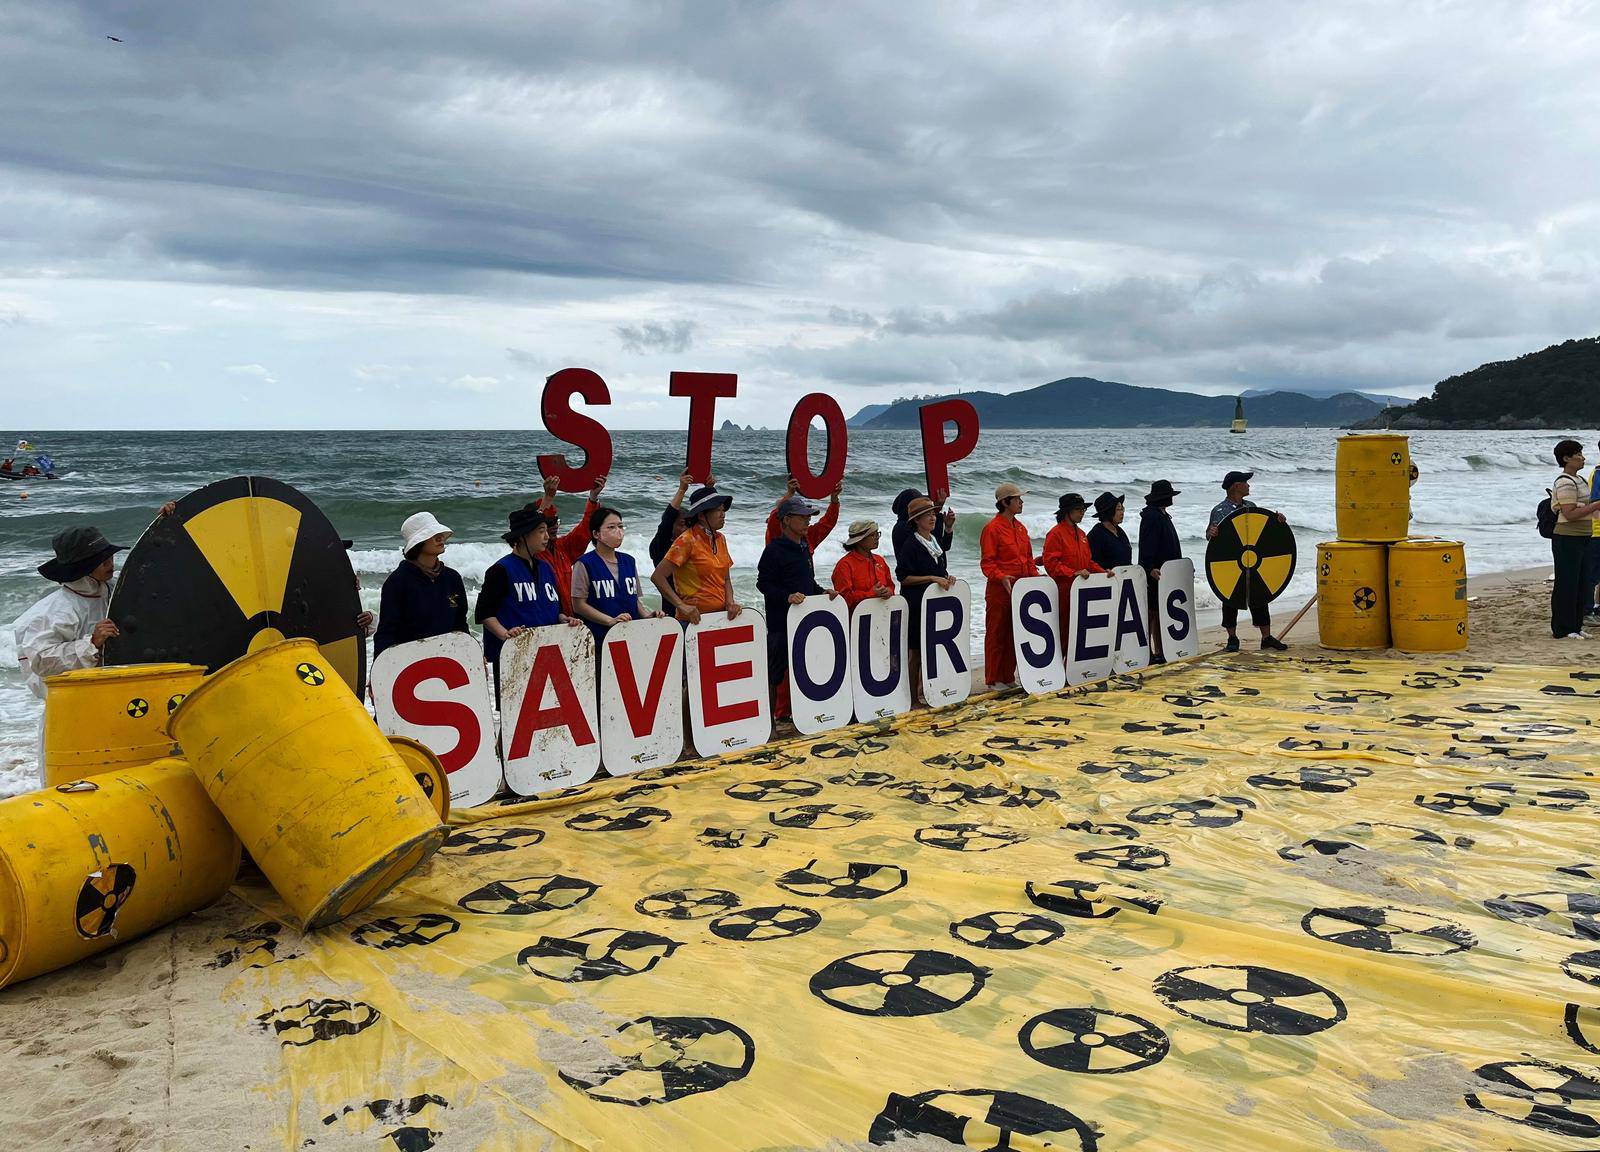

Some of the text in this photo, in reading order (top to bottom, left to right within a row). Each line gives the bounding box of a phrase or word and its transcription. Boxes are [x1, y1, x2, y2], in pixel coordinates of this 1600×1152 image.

[537, 368, 979, 500] STOP
[514, 582, 537, 602] YW
[592, 579, 615, 598] YW
[392, 579, 1190, 773] SAVE OUR SEAS
